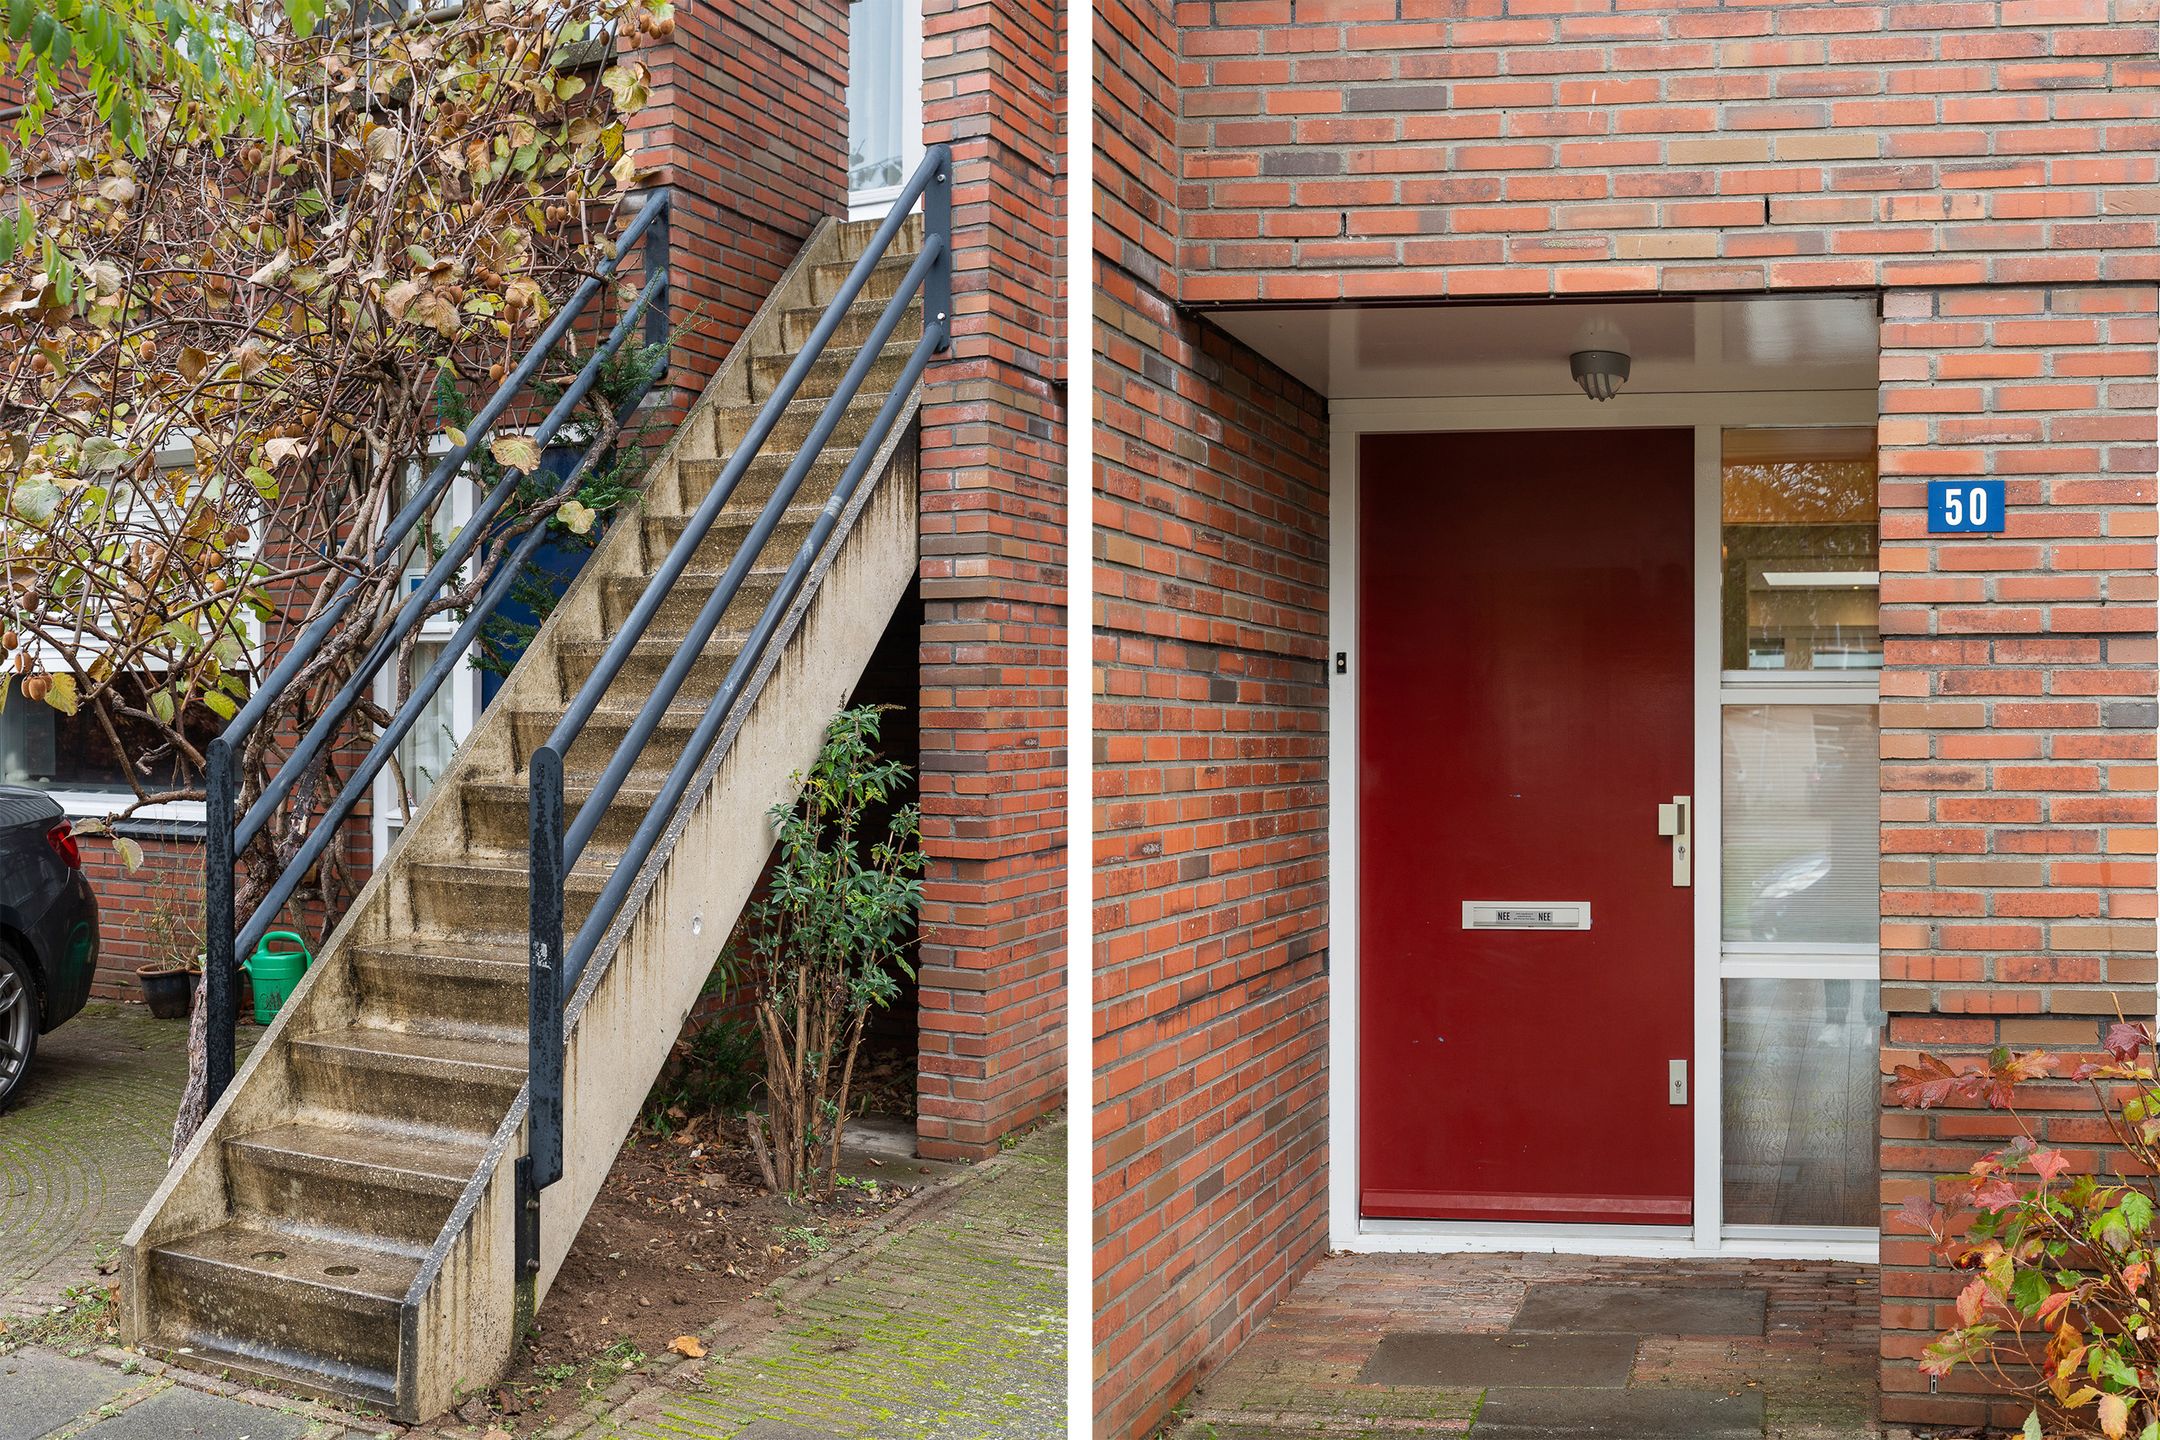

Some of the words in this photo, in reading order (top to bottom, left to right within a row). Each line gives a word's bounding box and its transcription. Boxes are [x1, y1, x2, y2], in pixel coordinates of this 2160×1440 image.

[1945, 487, 1987, 526] 50
[1497, 911, 1511, 921] NEE
[1538, 912, 1551, 922] NEE
